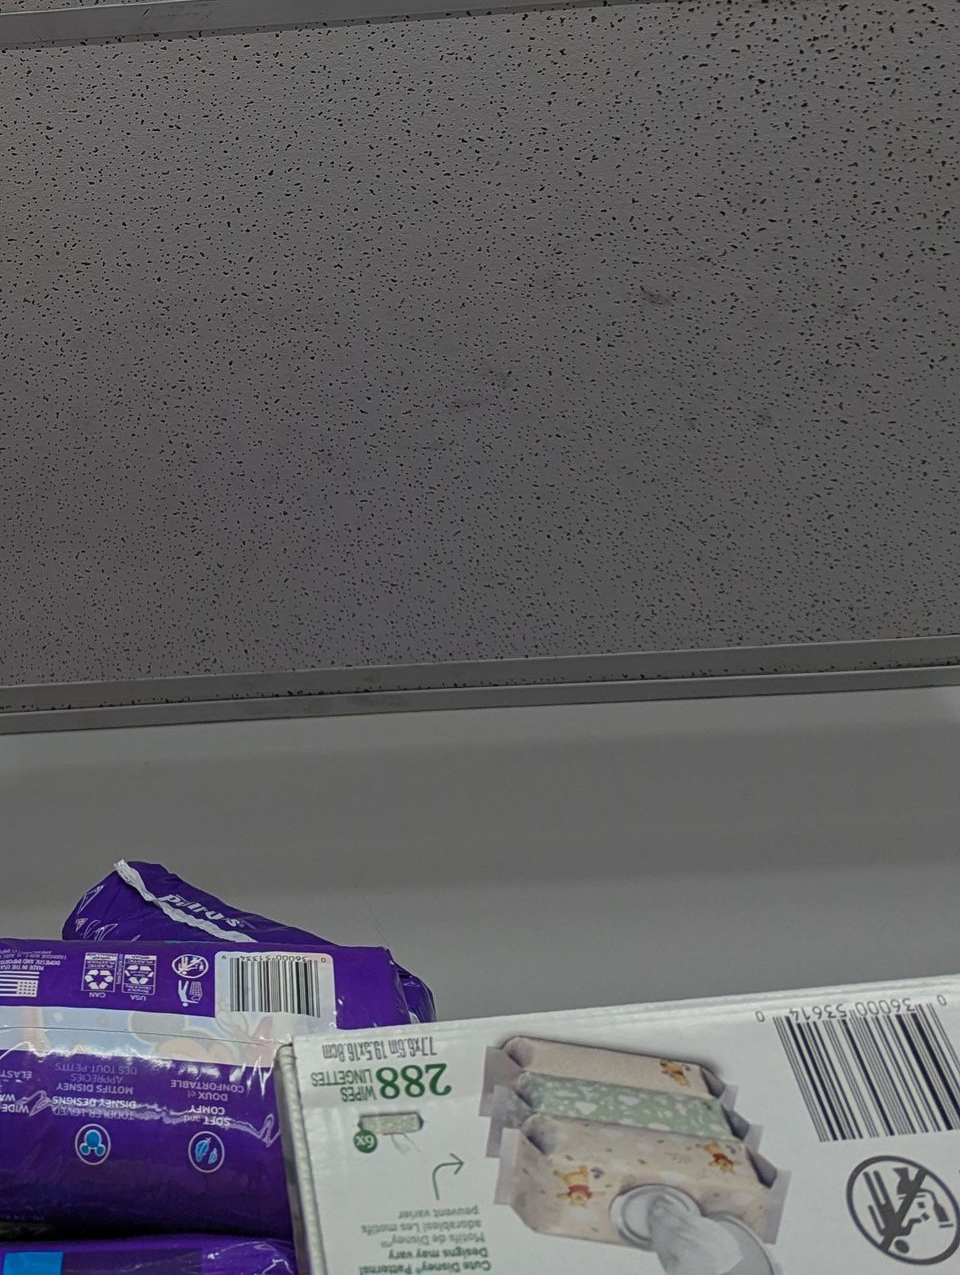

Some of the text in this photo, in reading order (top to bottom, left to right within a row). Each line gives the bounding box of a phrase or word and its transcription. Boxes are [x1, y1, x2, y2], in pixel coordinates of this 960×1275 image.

[89, 991, 107, 999] CAN
[130, 994, 147, 1002] USA
[754, 993, 947, 1024] 0 36000 53614 0
[310, 1068, 373, 1088] LINGETTES
[375, 1063, 453, 1100] 288
[56, 1082, 134, 1095] MOTIFS DISNEY
[170, 1078, 245, 1094] CONFORTABLE
[197, 1091, 229, 1102] DOUX
[340, 1085, 376, 1103] WIPES
[3, 1102, 30, 1115] WIDE
[51, 1095, 137, 1110] DISNEY DESIGNS
[188, 1104, 226, 1116] COMFY
[202, 1114, 231, 1127] SOFT
[397, 1205, 480, 1220] peuvent varier
[361, 1223, 398, 1236] motifs
[399, 1222, 420, 1232] Les
[431, 1233, 446, 1243] de
[449, 1232, 486, 1244] Motifs
[388, 1245, 489, 1260] Designs may vary
[462, 1260, 491, 1272] Cute
